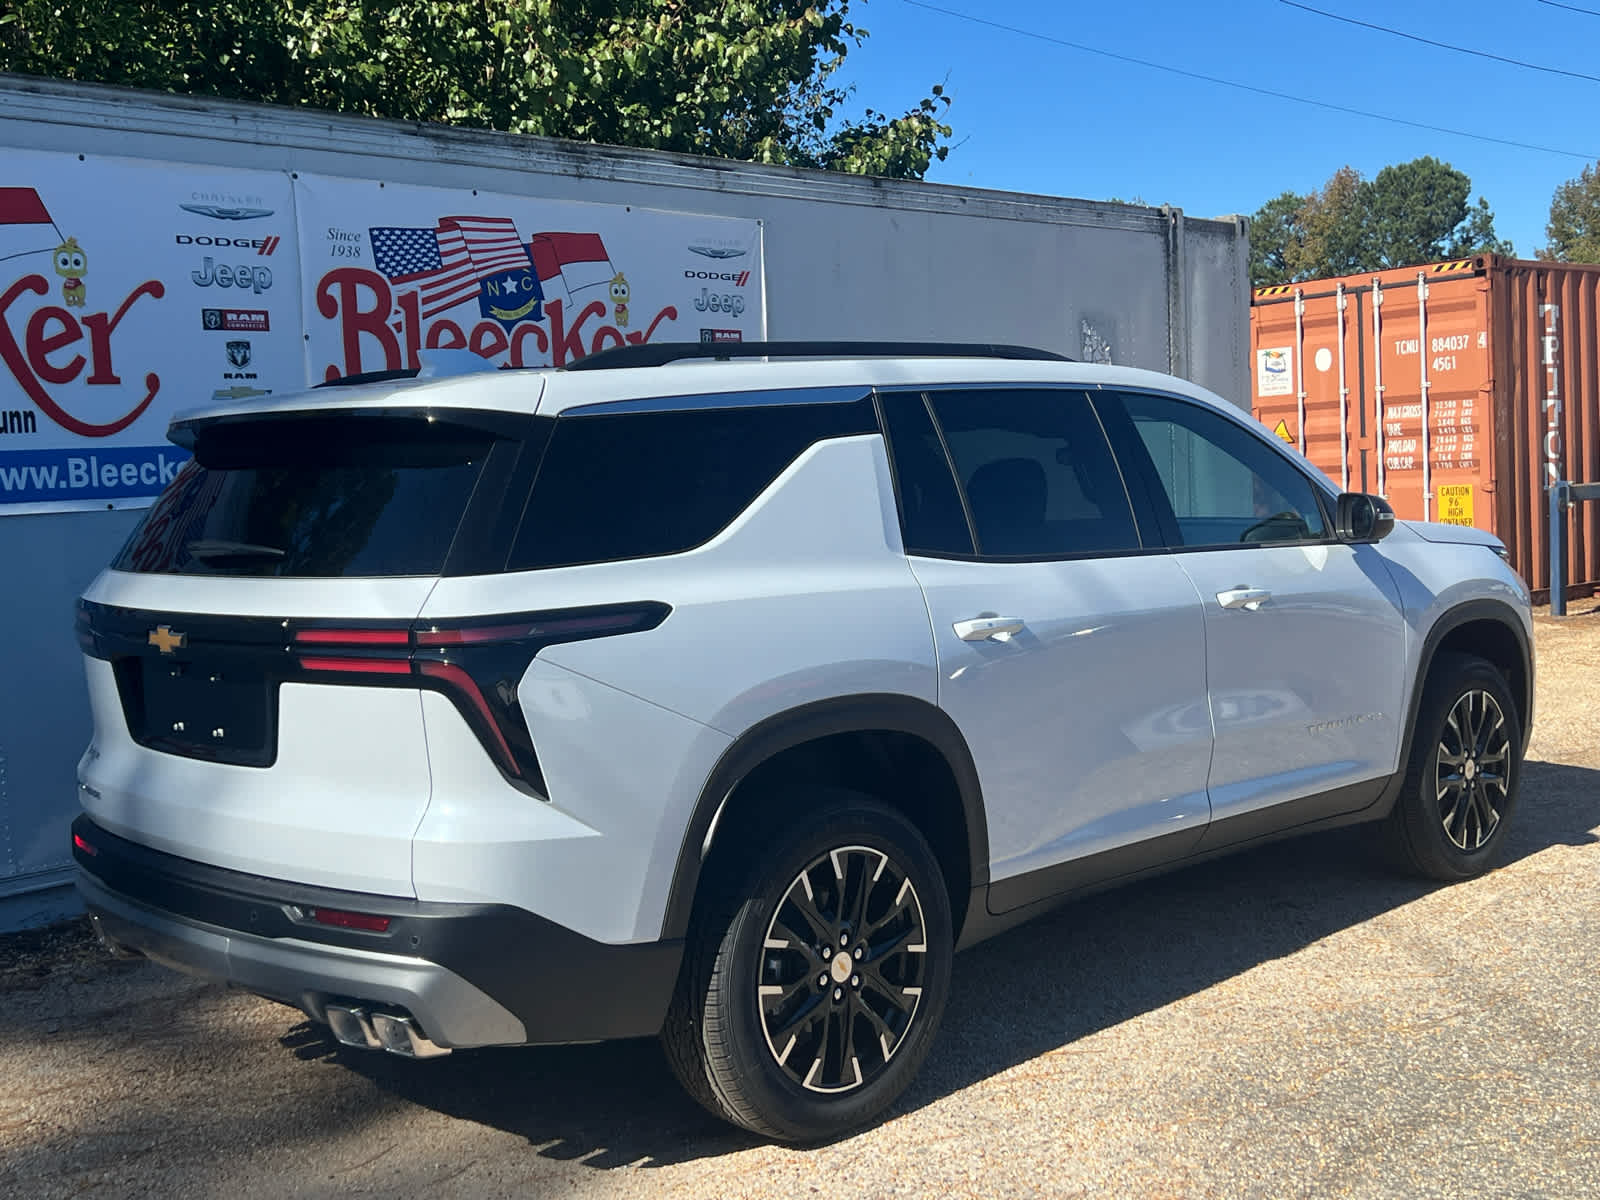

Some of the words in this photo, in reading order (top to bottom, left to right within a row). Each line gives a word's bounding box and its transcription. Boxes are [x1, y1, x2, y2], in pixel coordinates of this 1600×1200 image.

[327, 227, 361, 242] Since
[175, 235, 265, 249] DODGE
[331, 244, 361, 258] 1938
[191, 256, 272, 295] Jeep
[684, 270, 740, 282] DODGE
[486, 280, 500, 297] N
[521, 276, 534, 292] C
[694, 287, 745, 319] Jeep
[226, 313, 265, 322] RAM
[715, 332, 740, 340] RAM
[1394, 339, 1419, 355] TCNU
[1431, 334, 1470, 353] 884037
[1432, 355, 1457, 372] 45G1
[223, 372, 257, 380] RAM
[1440, 487, 1471, 497] CAUTION
[1447, 507, 1464, 518] HIGH
